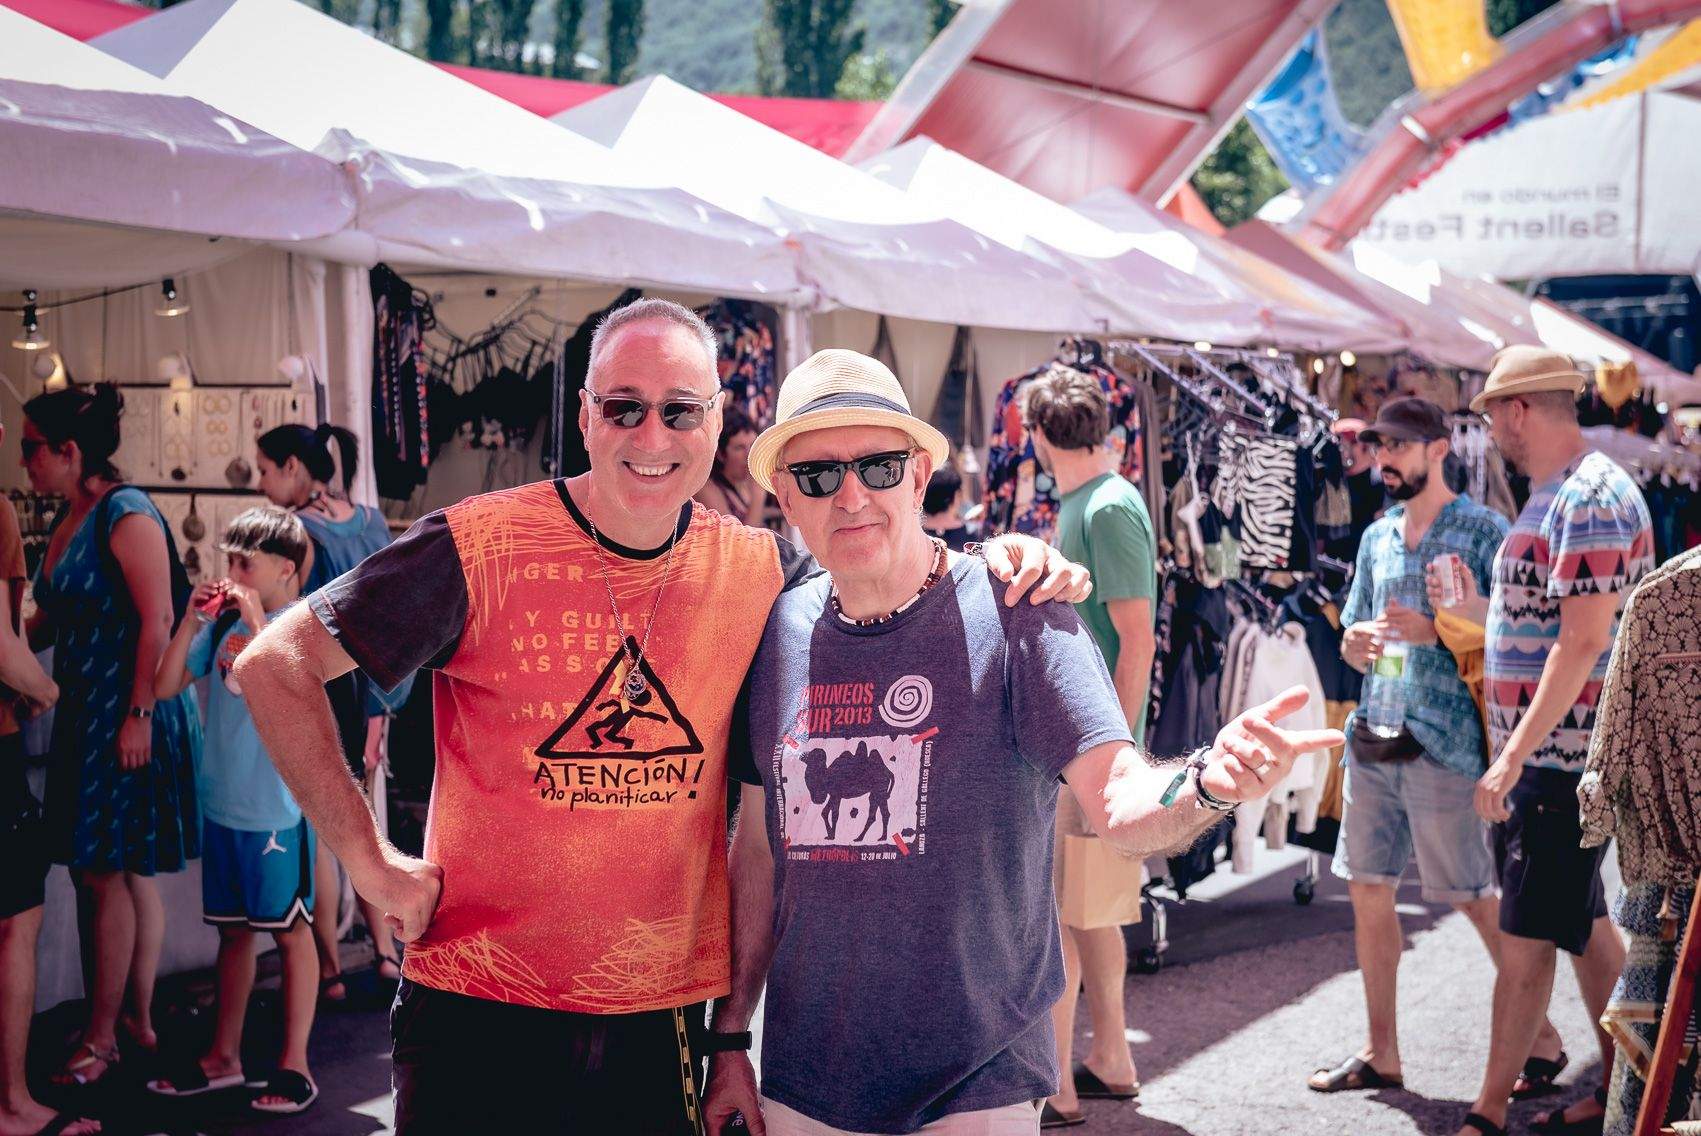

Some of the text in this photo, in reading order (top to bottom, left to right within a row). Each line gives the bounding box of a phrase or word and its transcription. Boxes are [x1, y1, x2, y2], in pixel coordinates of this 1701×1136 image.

[562, 609, 652, 630] GUILT
[511, 633, 547, 653] NO
[834, 707, 873, 725] 2013
[540, 785, 679, 812] no planificar
[919, 803, 927, 827] SALLENT
